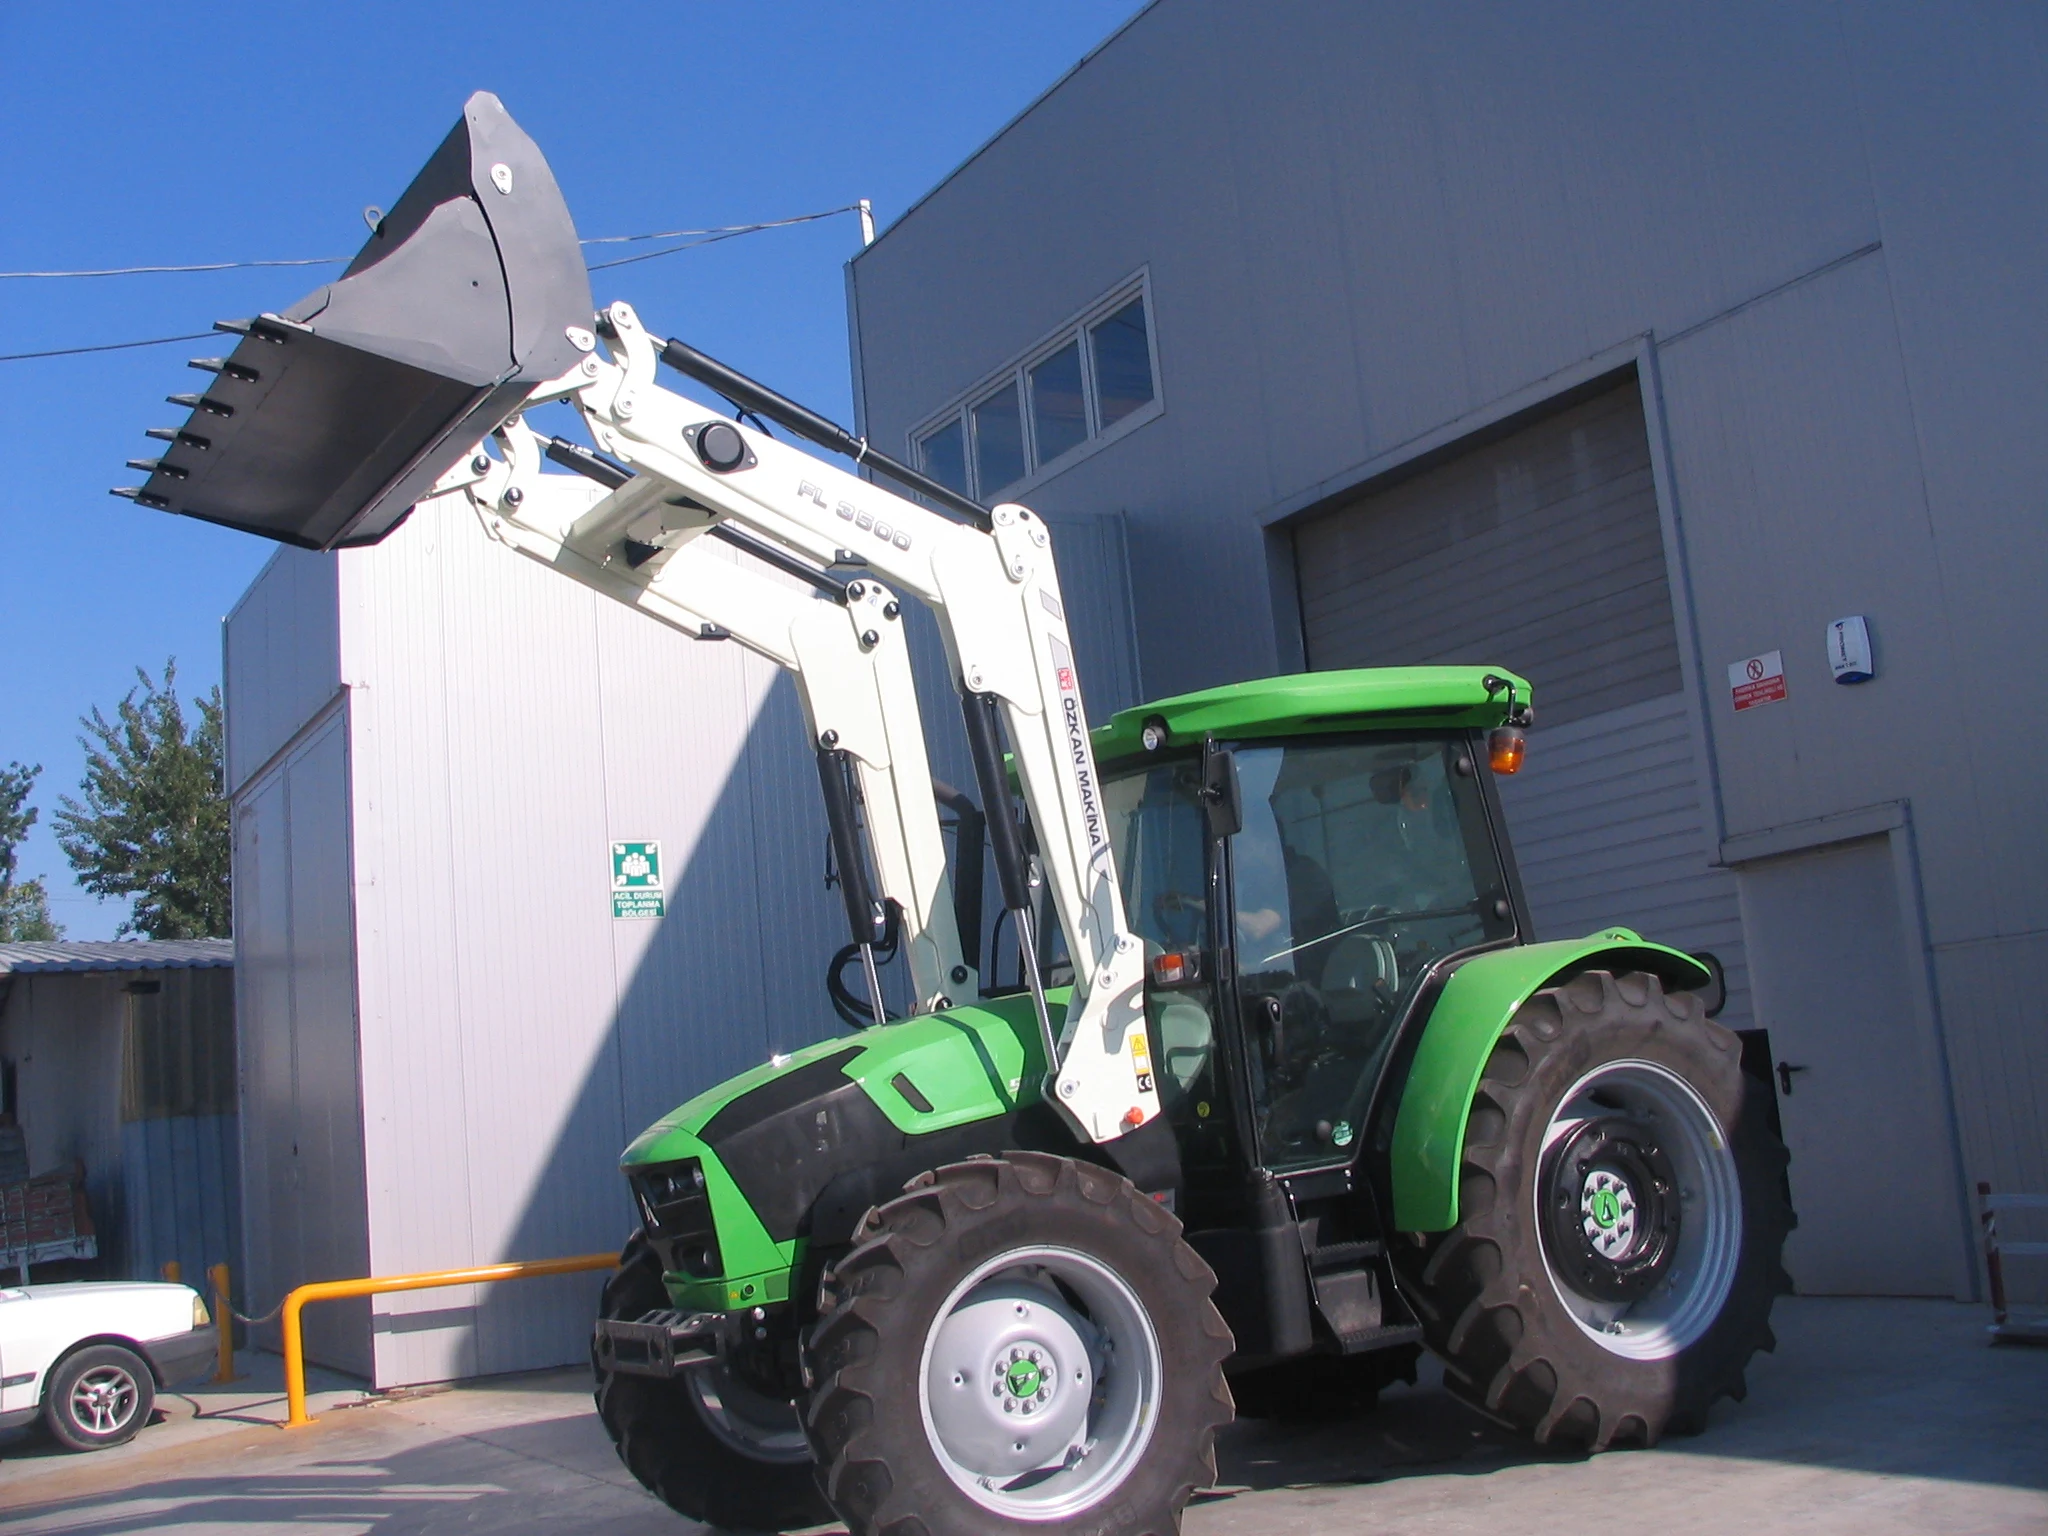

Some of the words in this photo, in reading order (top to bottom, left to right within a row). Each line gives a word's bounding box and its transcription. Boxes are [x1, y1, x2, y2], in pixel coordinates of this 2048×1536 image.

[797, 479, 827, 510] FL
[836, 500, 912, 552] 3500
[1063, 697, 1085, 765] ÖZKAN
[1078, 770, 1101, 847] MAKİNA
[616, 900, 661, 908] TOPLANMA
[633, 891, 662, 900] DURUM
